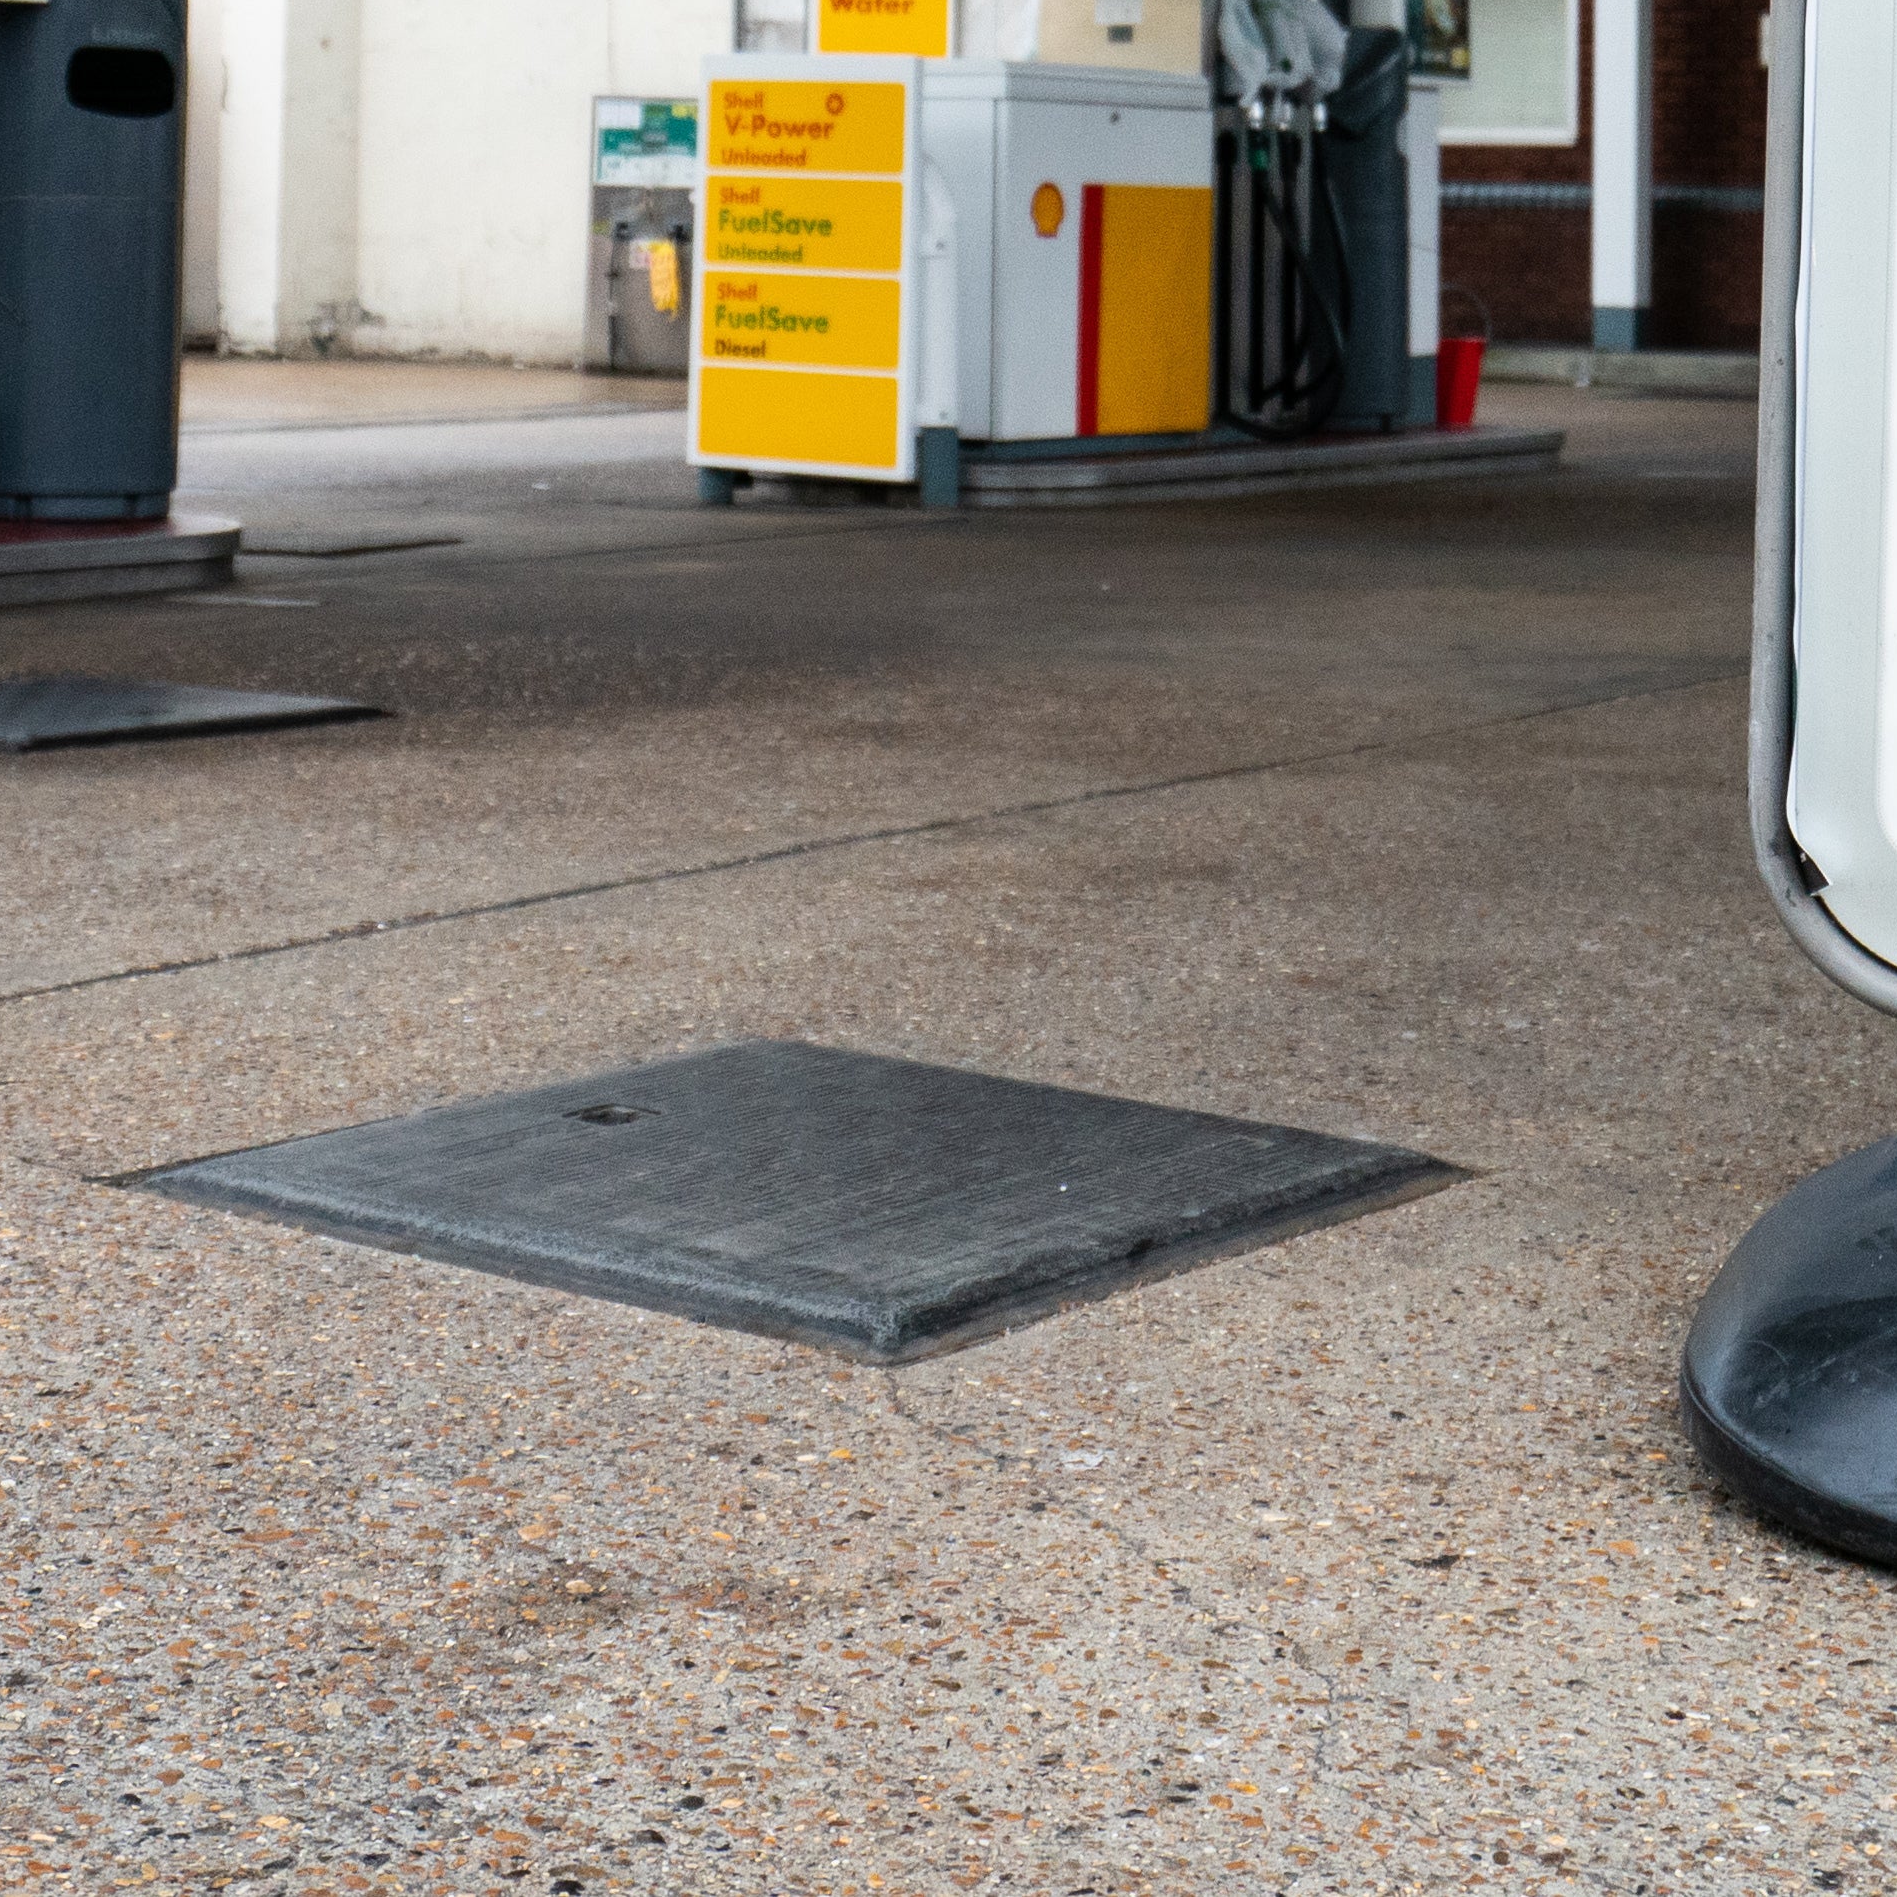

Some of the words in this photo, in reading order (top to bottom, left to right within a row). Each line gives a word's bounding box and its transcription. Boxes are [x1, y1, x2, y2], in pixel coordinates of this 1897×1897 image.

[724, 91, 764, 110] Shell
[724, 113, 835, 140] V-Power
[721, 147, 807, 167] Unleaded
[719, 186, 760, 205] Shell
[718, 208, 833, 237] FuelSave
[717, 242, 804, 262] Unleaded
[717, 282, 758, 301] Shell
[715, 304, 830, 334] FuelSave
[714, 338, 767, 358] Diesel
